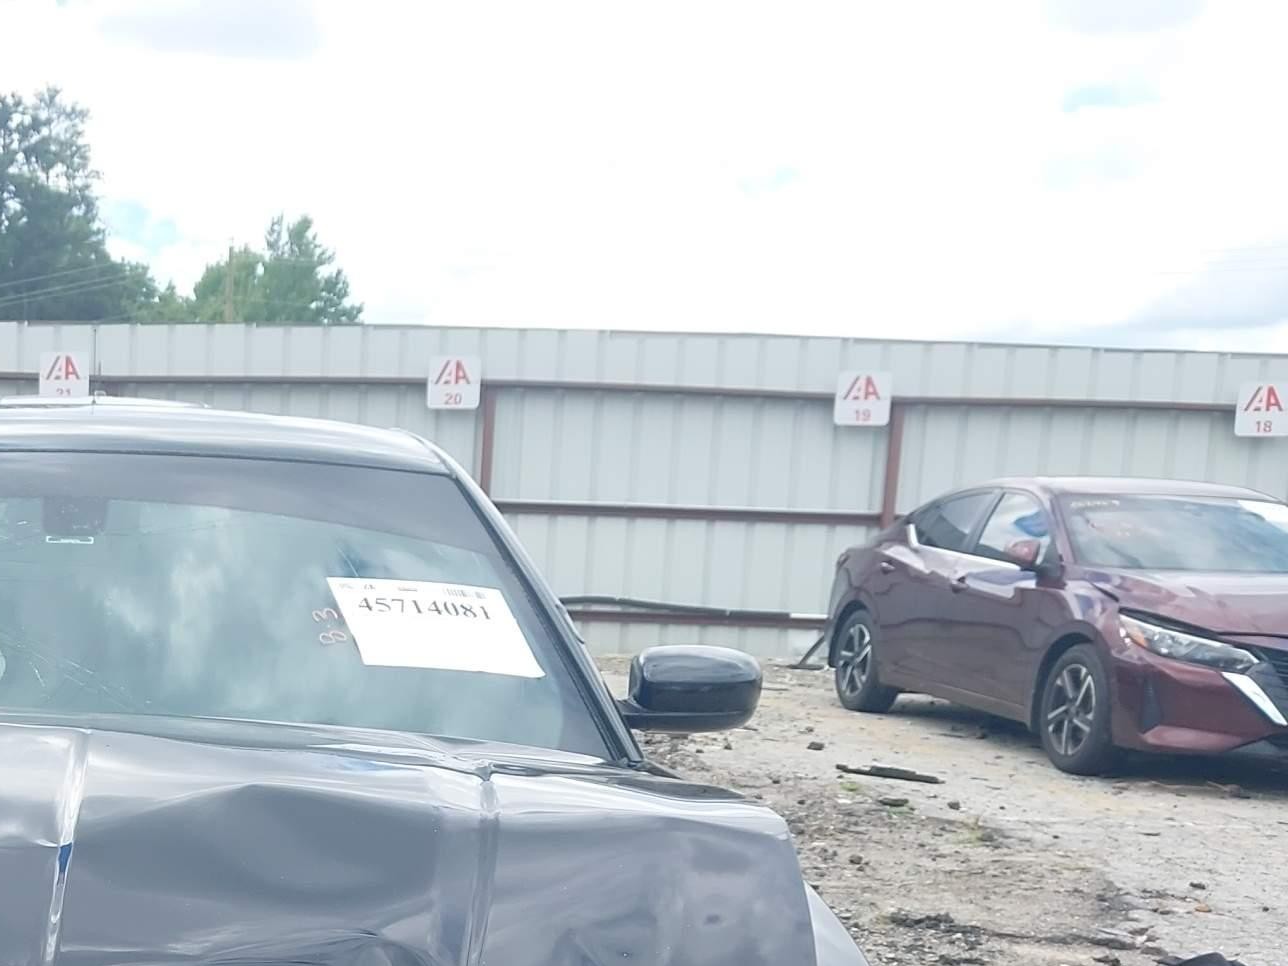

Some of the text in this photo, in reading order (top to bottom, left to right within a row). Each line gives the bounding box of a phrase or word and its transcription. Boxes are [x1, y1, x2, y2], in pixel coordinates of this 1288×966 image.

[444, 392, 462, 405] 20
[855, 409, 872, 422] 19
[1255, 419, 1273, 433] 18
[358, 596, 491, 621] 45714081
